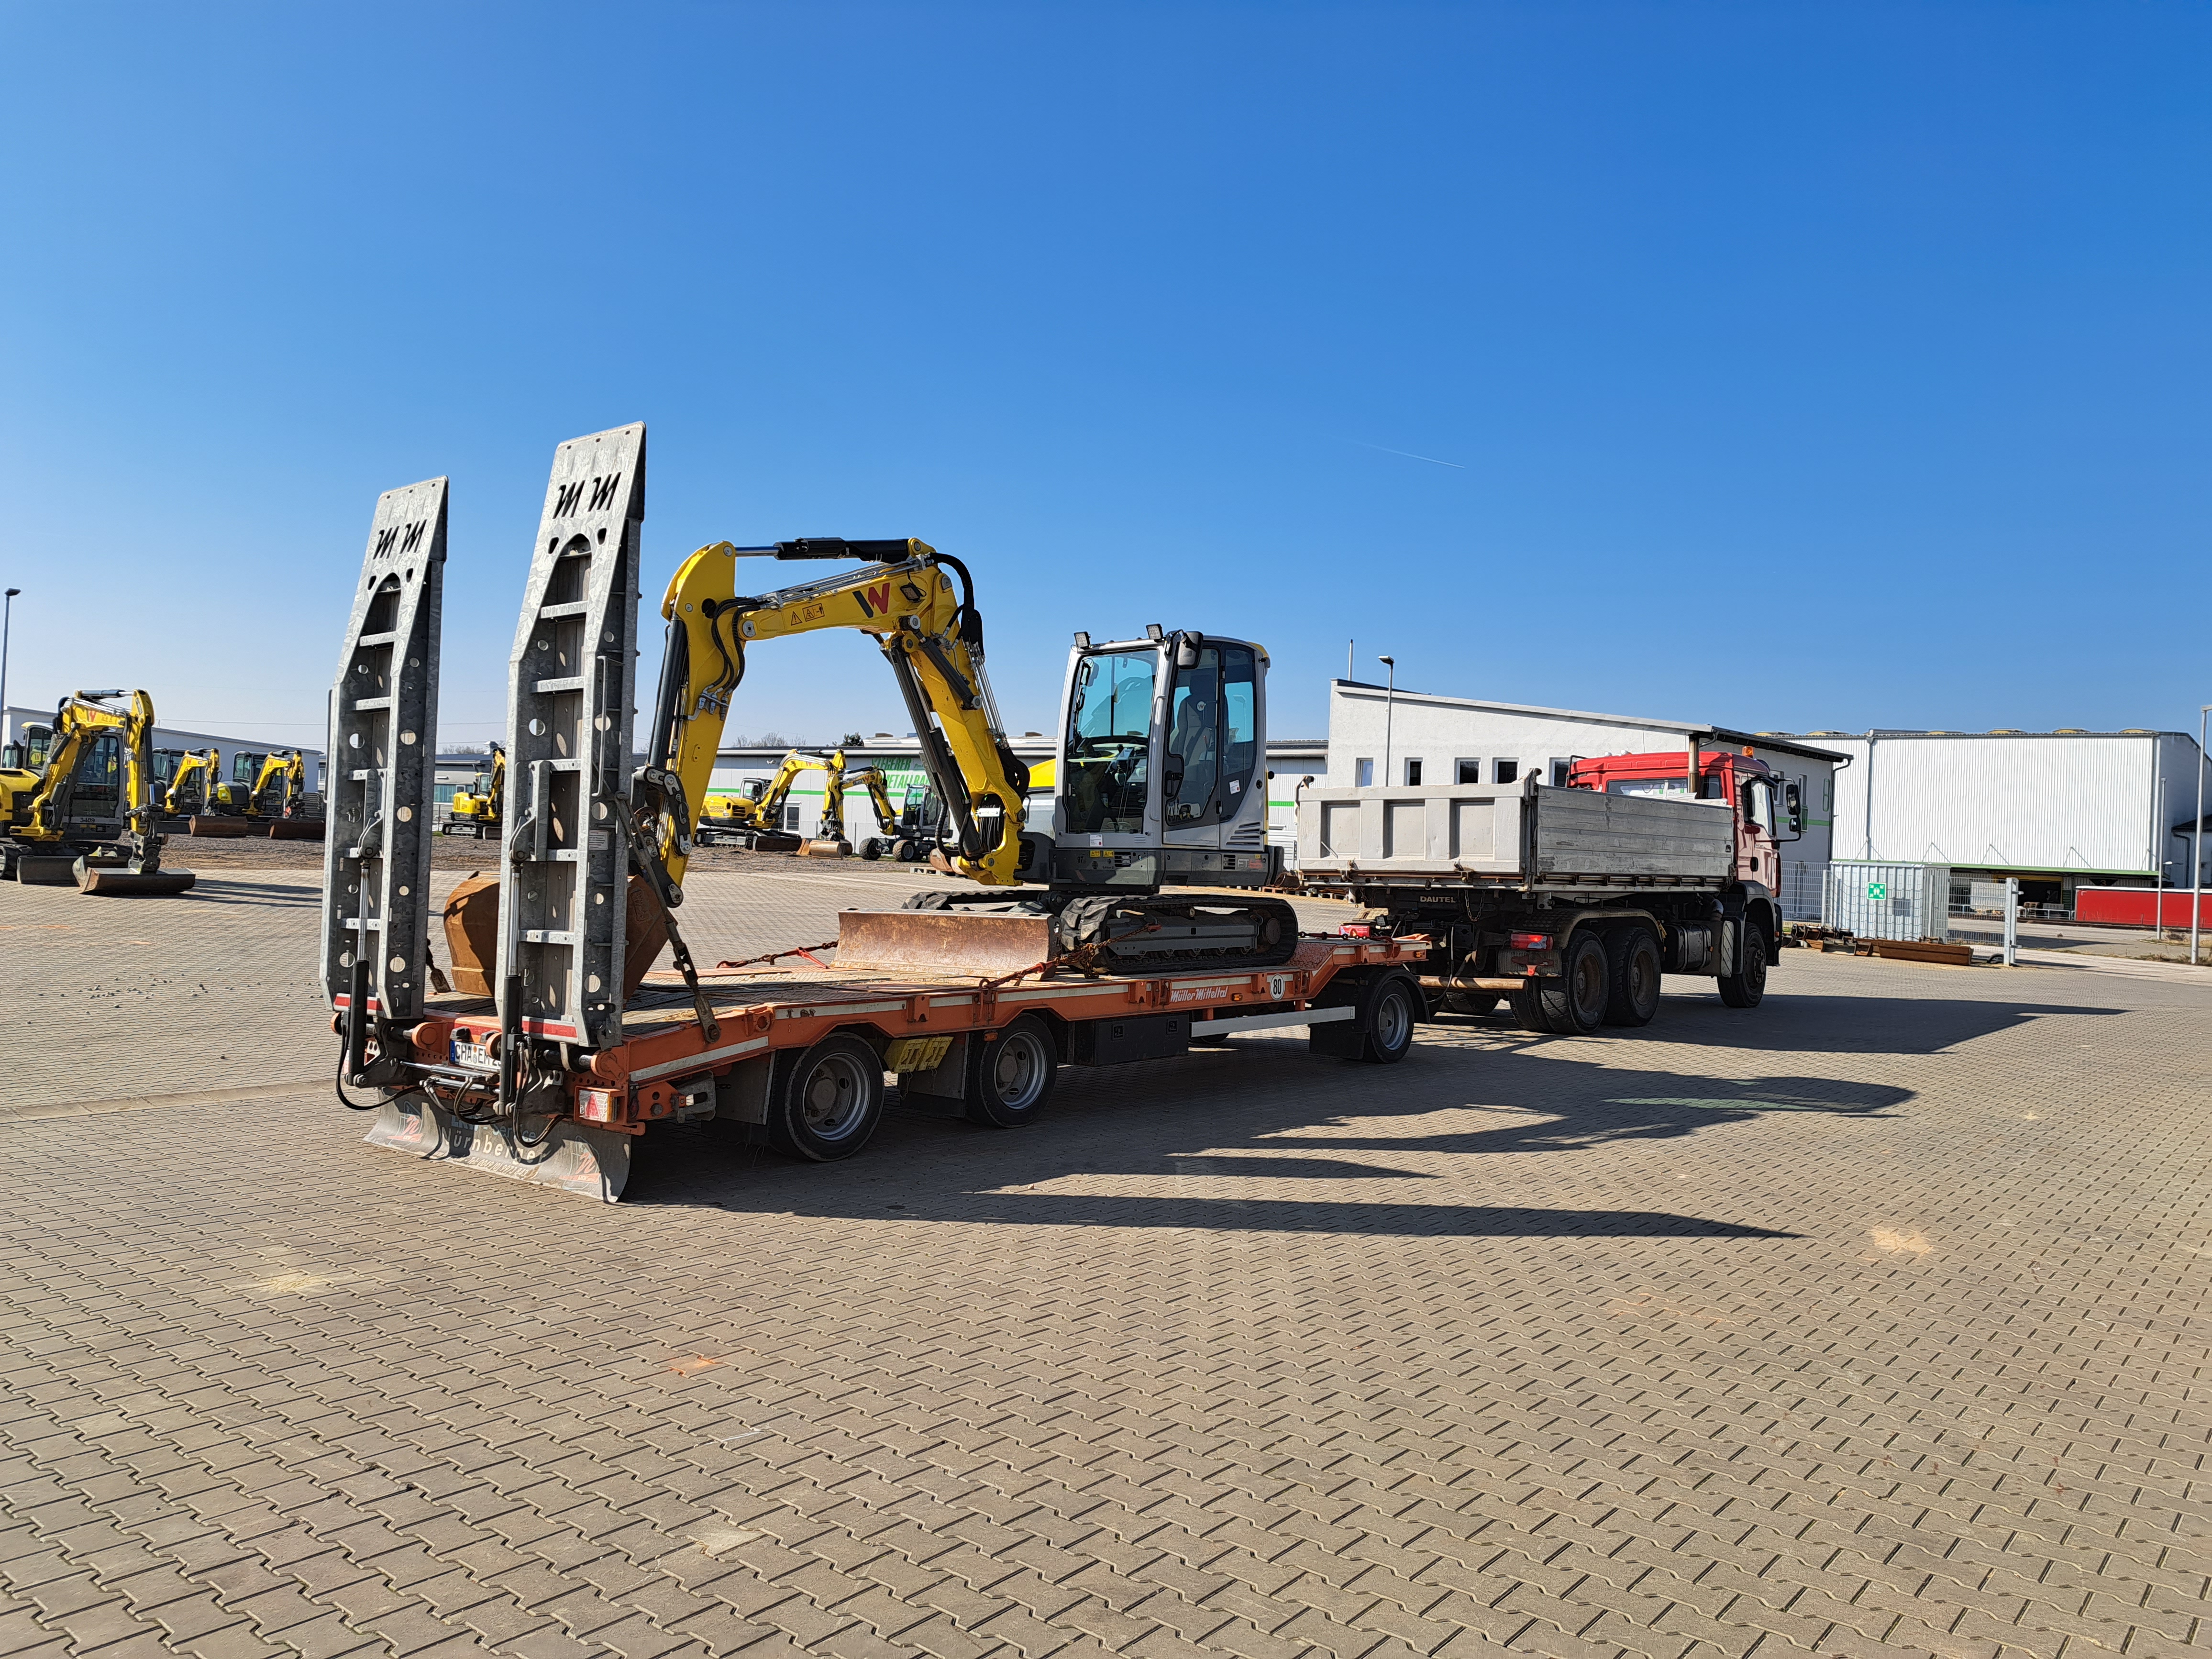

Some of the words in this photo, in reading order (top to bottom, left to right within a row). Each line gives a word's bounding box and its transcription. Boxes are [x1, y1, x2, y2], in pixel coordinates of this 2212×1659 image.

[1171, 989, 1195, 1003] Müller
[1195, 986, 1228, 1001] Mitteltal
[1273, 978, 1282, 995] 80
[455, 1044, 472, 1062] CHA
[441, 1126, 549, 1165] Nürnberger
